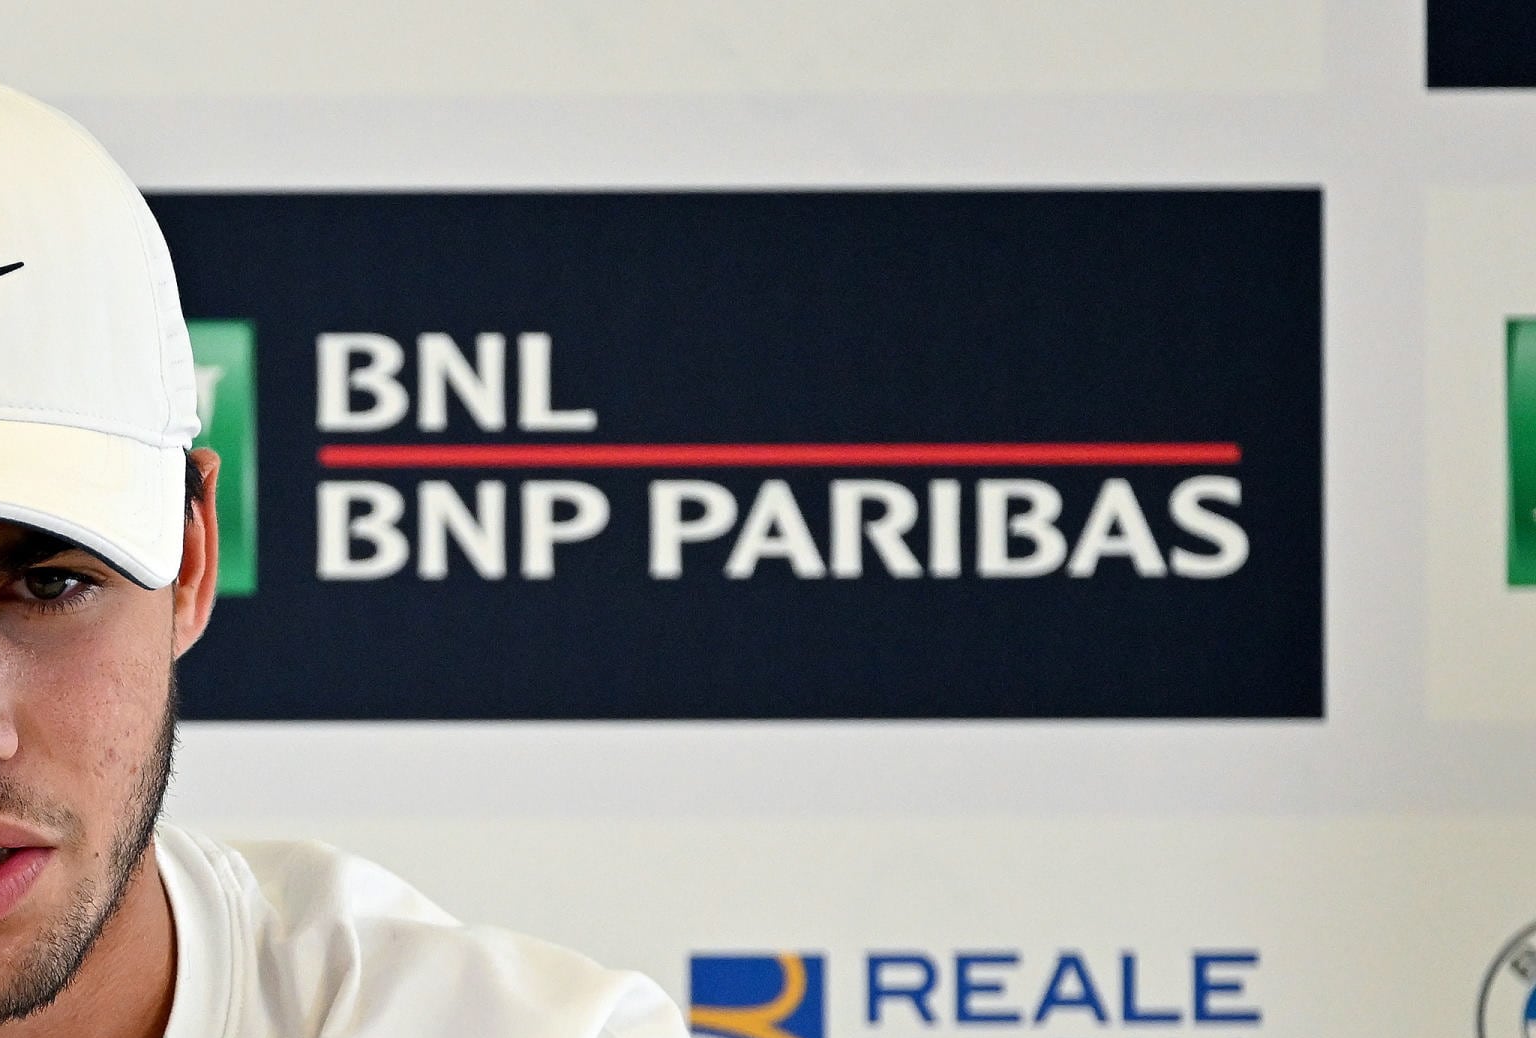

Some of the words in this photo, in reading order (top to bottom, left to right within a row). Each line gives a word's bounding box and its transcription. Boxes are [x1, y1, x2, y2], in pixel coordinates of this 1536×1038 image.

[316, 332, 598, 432] BNL
[316, 479, 611, 581] BNP
[648, 475, 1250, 580] PARIBAS
[866, 951, 1261, 1024] REALE
